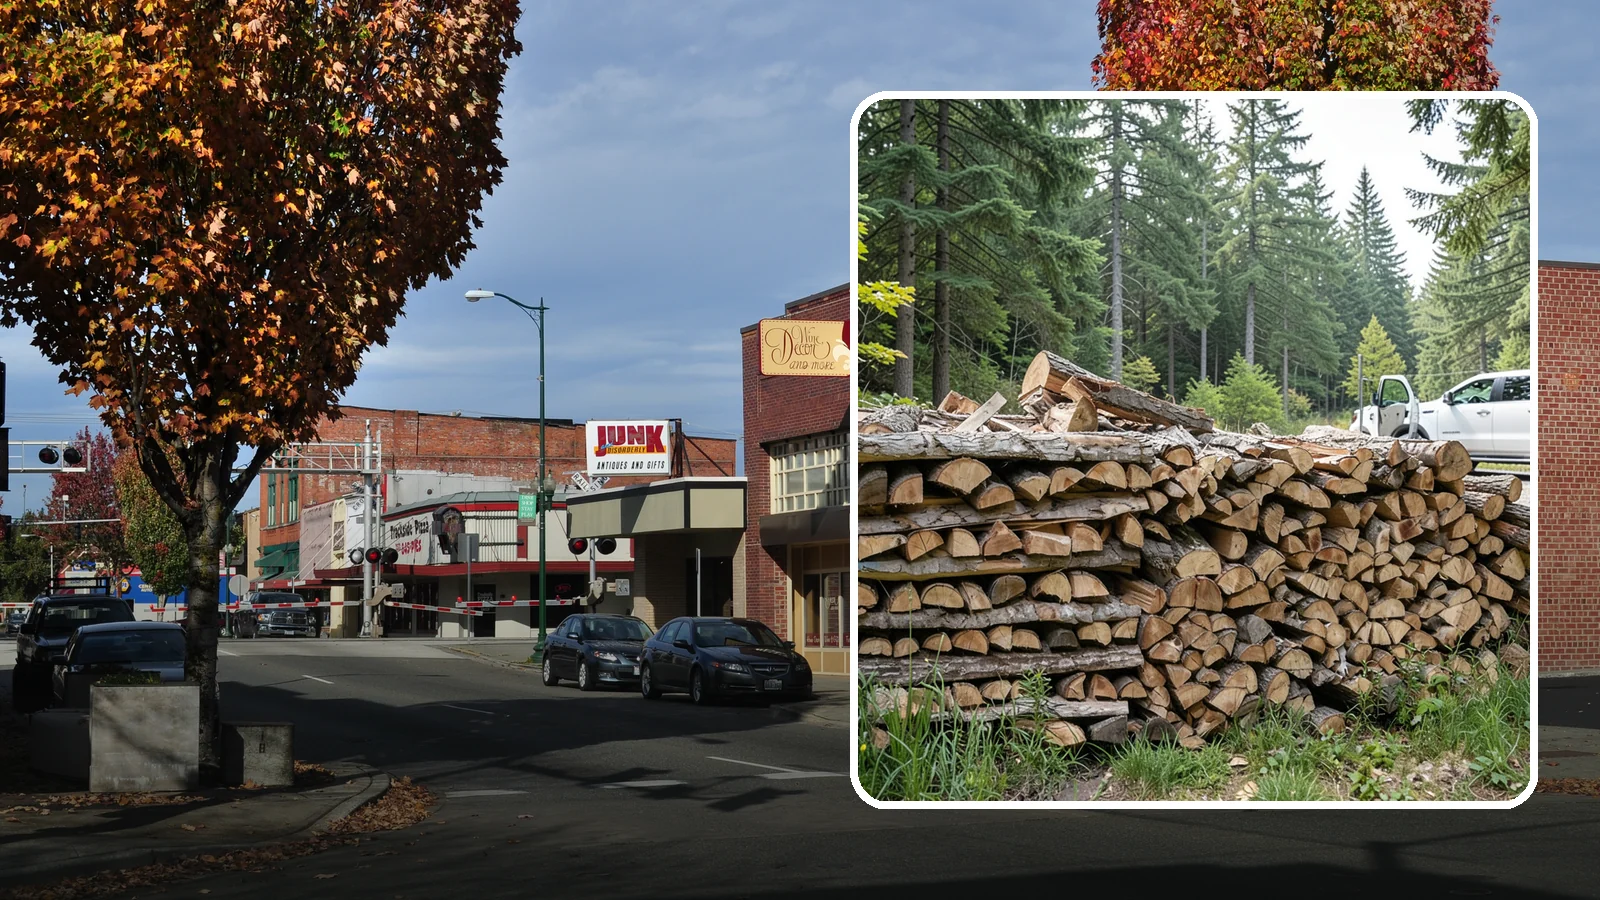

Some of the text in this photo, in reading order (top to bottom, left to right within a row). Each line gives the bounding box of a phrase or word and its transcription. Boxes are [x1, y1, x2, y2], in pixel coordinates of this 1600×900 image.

[595, 425, 665, 457] JUNK
[607, 446, 646, 454] DISORDERLY
[597, 460, 665, 470] ANTIQUES AND GIFTS
[414, 520, 429, 534] Pizza
